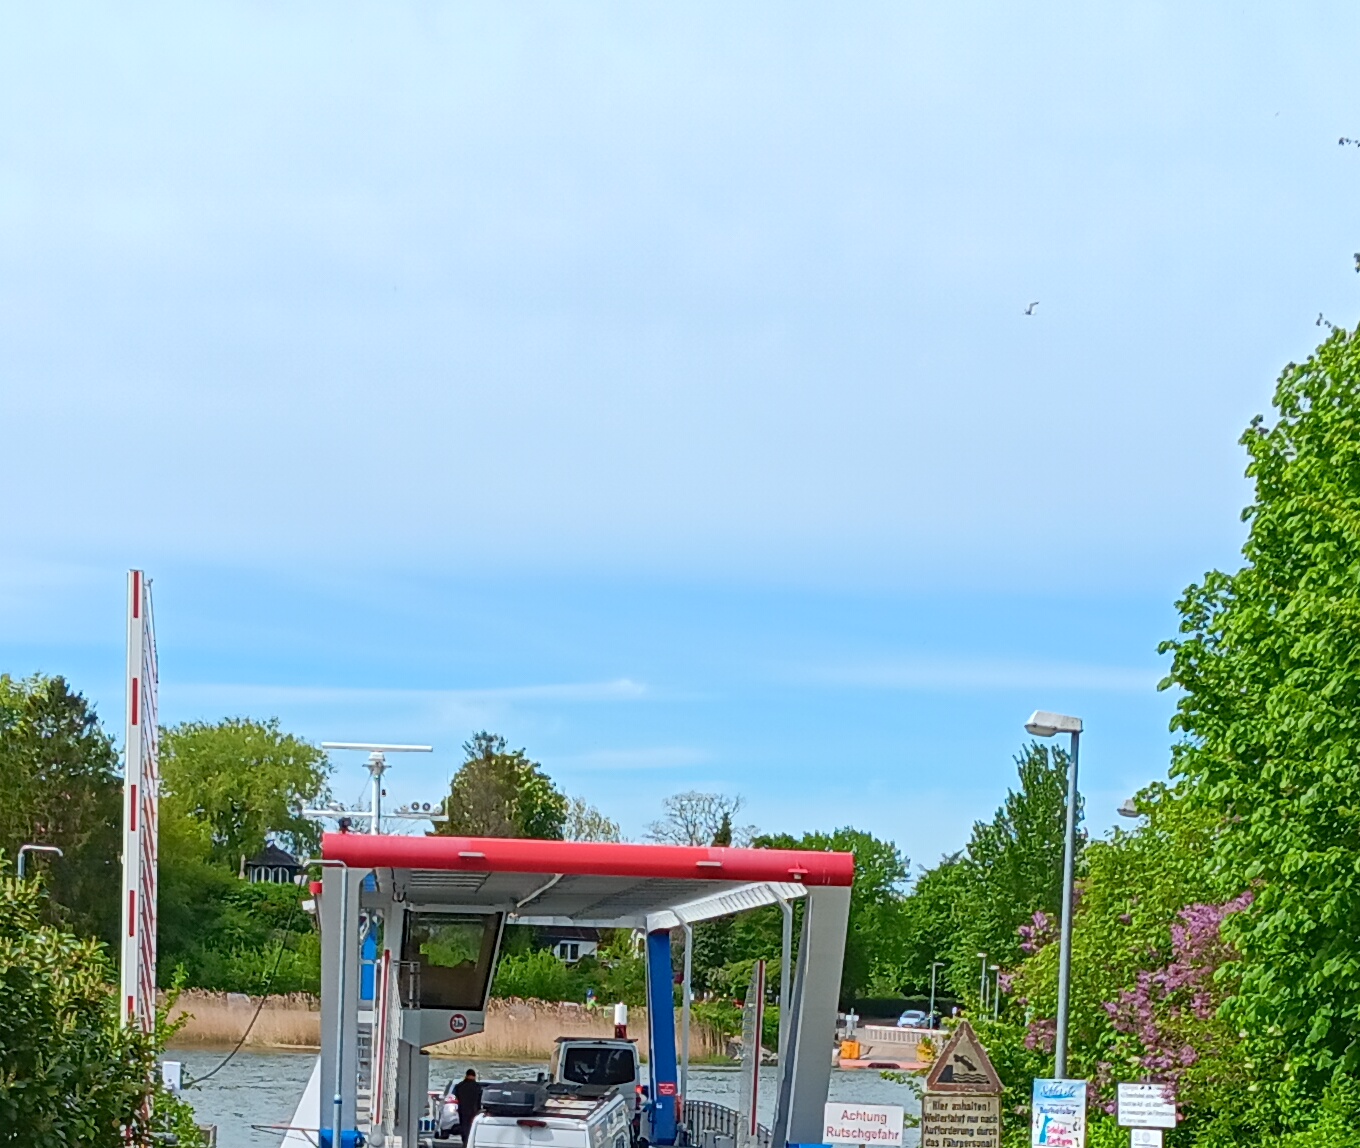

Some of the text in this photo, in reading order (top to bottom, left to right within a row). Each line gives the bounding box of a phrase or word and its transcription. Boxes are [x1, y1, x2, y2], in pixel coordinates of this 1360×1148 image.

[932, 1099, 991, 1111] Hier anhalten!
[841, 1109, 887, 1125] Achtung
[924, 1112, 997, 1123] Weiterfahrt nur nach
[826, 1126, 900, 1141] Rutschgefahr
[924, 1125, 997, 1137] Aufforderung durch
[925, 1138, 939, 1147] das
